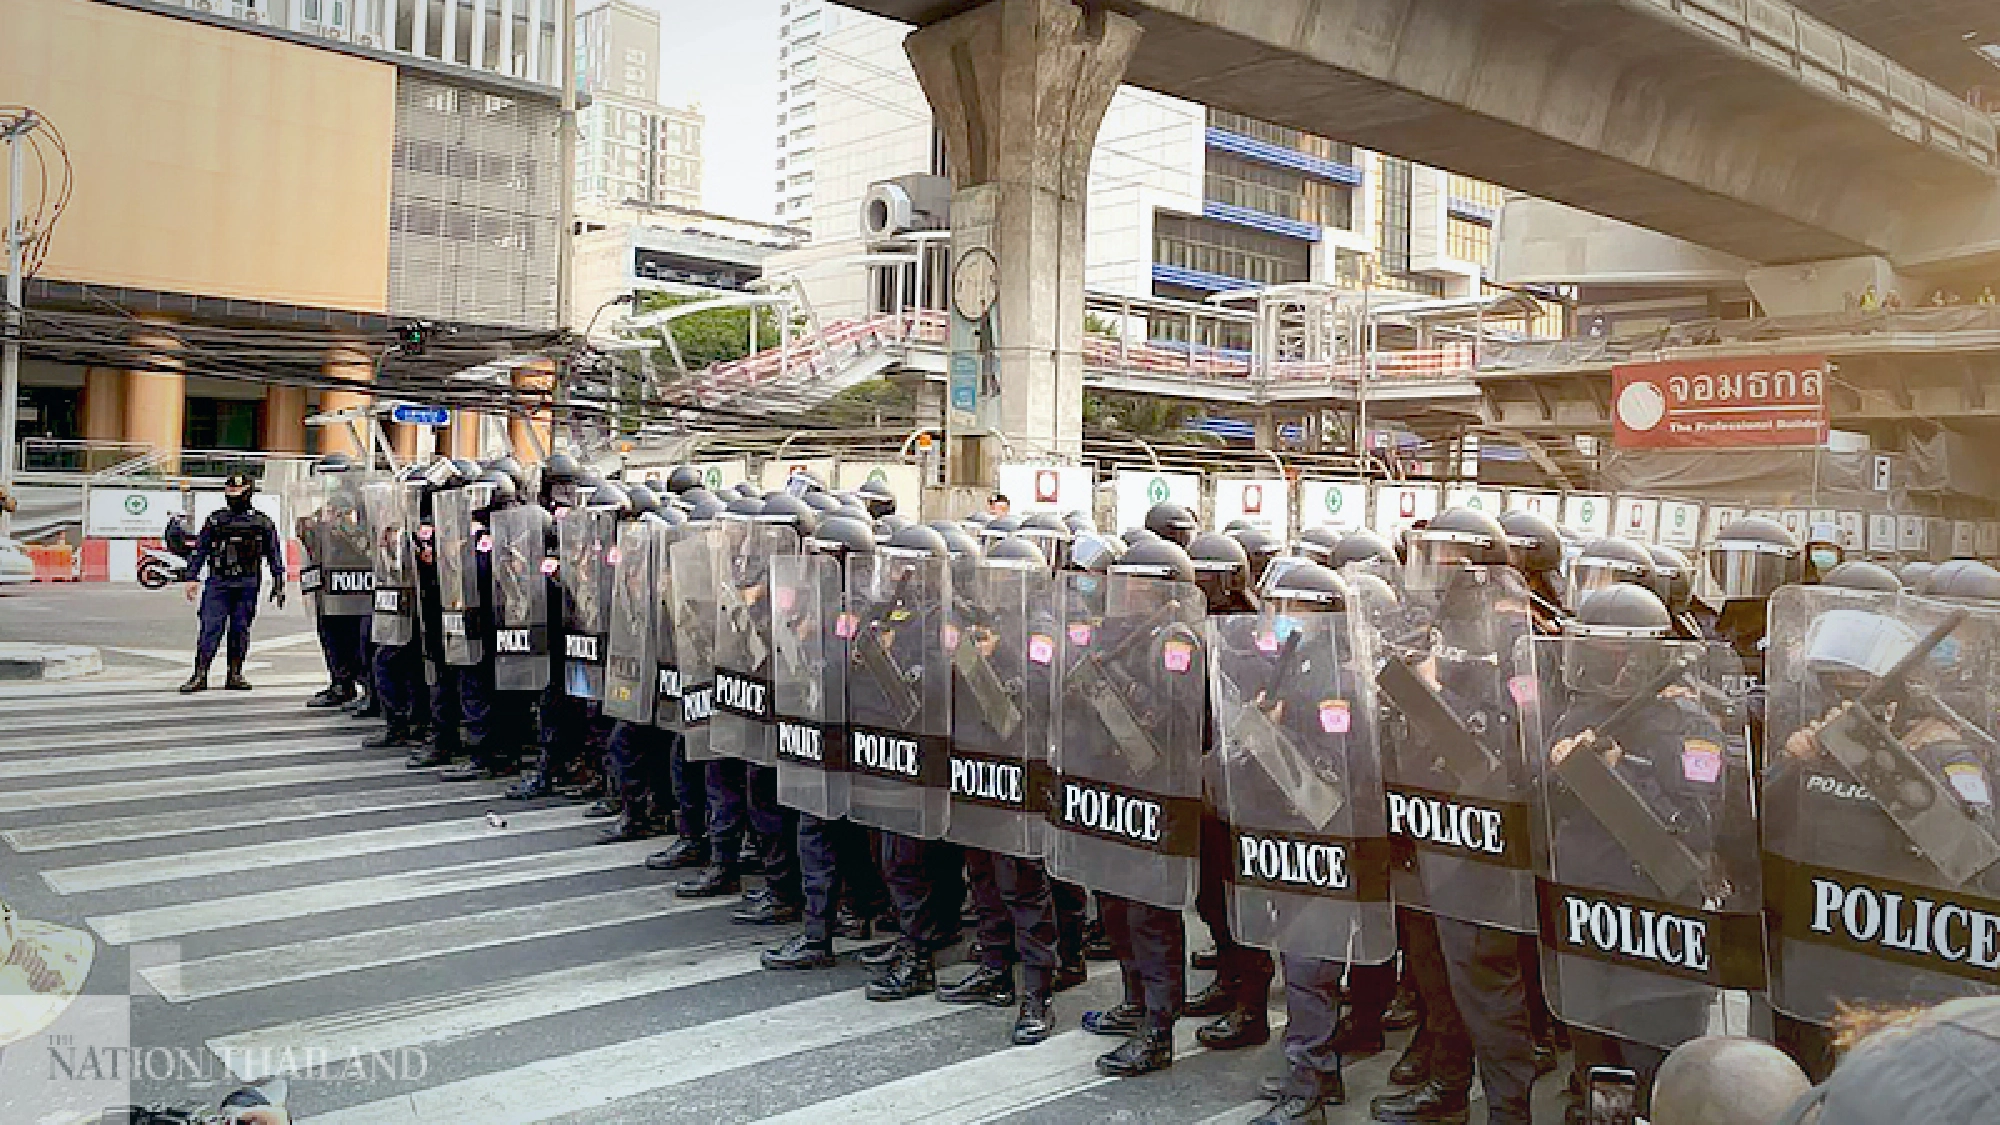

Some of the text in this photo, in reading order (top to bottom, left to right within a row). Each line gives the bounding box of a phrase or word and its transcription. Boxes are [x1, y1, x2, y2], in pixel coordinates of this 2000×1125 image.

[1669, 369, 1823, 401] จอมธกล
[331, 571, 376, 591] POLIC
[659, 669, 682, 698] POL
[716, 674, 766, 716] POLICE
[778, 721, 823, 761] POLICE
[853, 731, 918, 776] POLICE
[950, 758, 1022, 803] POLICE
[1064, 783, 1162, 841] POLICE
[1387, 791, 1506, 853] POLICE
[1239, 835, 1350, 888] POLICE
[1564, 896, 1711, 971] POLICE
[1811, 878, 2000, 969] POLICE
